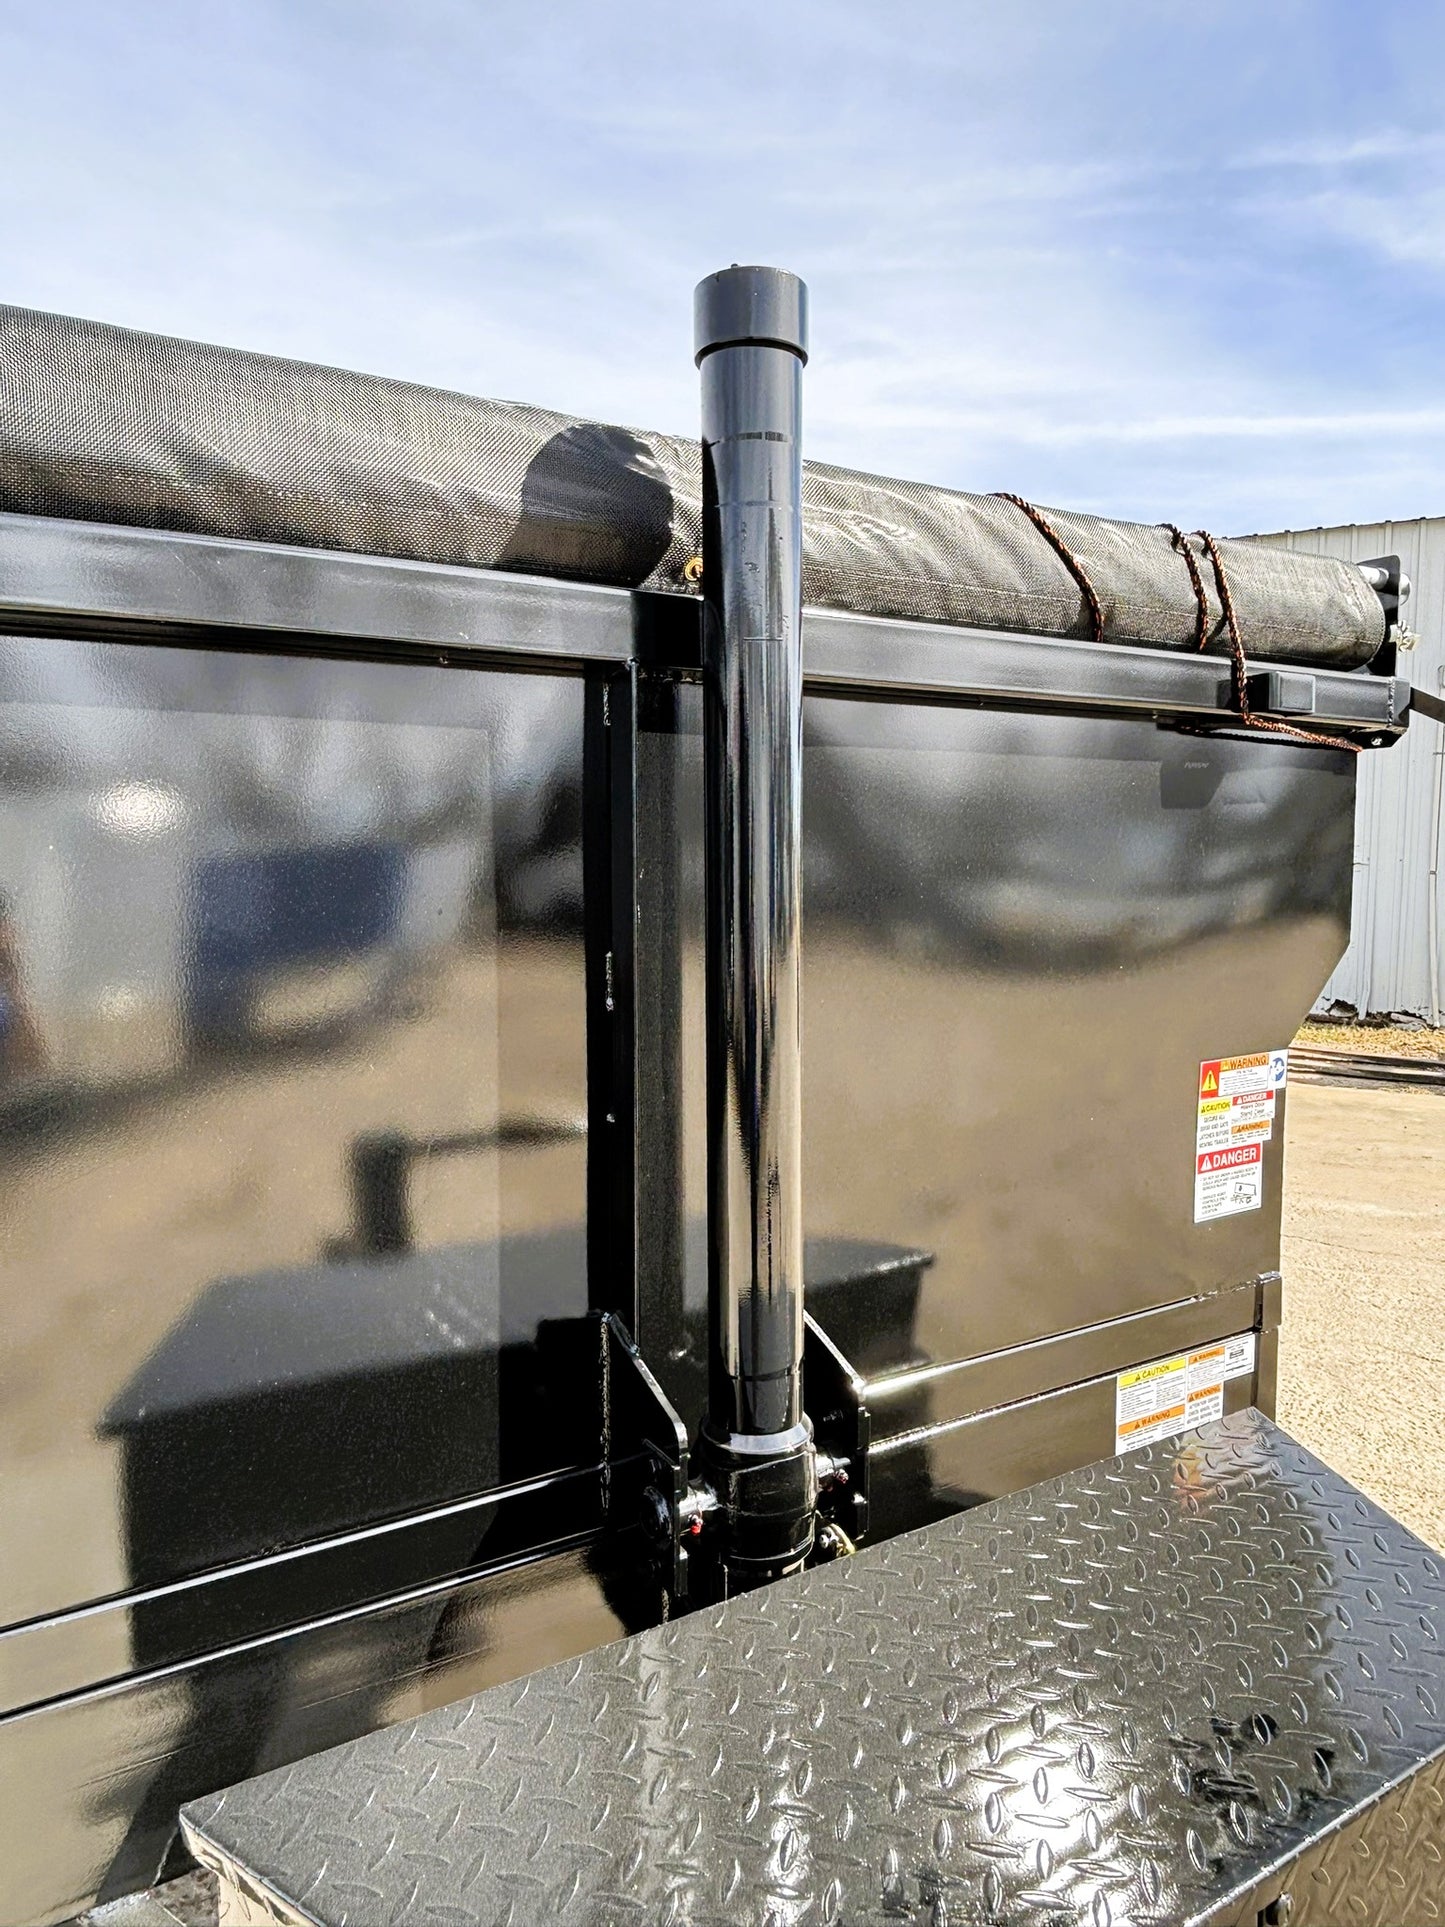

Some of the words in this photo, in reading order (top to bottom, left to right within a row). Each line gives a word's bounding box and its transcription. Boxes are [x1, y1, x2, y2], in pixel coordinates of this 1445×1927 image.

[1229, 1056, 1266, 1069] WARNING
[1242, 1093, 1267, 1104] DANGER
[1206, 1101, 1230, 1112] CAUTION
[1213, 1147, 1257, 1168] DANGER
[1142, 1365, 1170, 1379] CAUTION
[1140, 1410, 1171, 1426] WARNING
